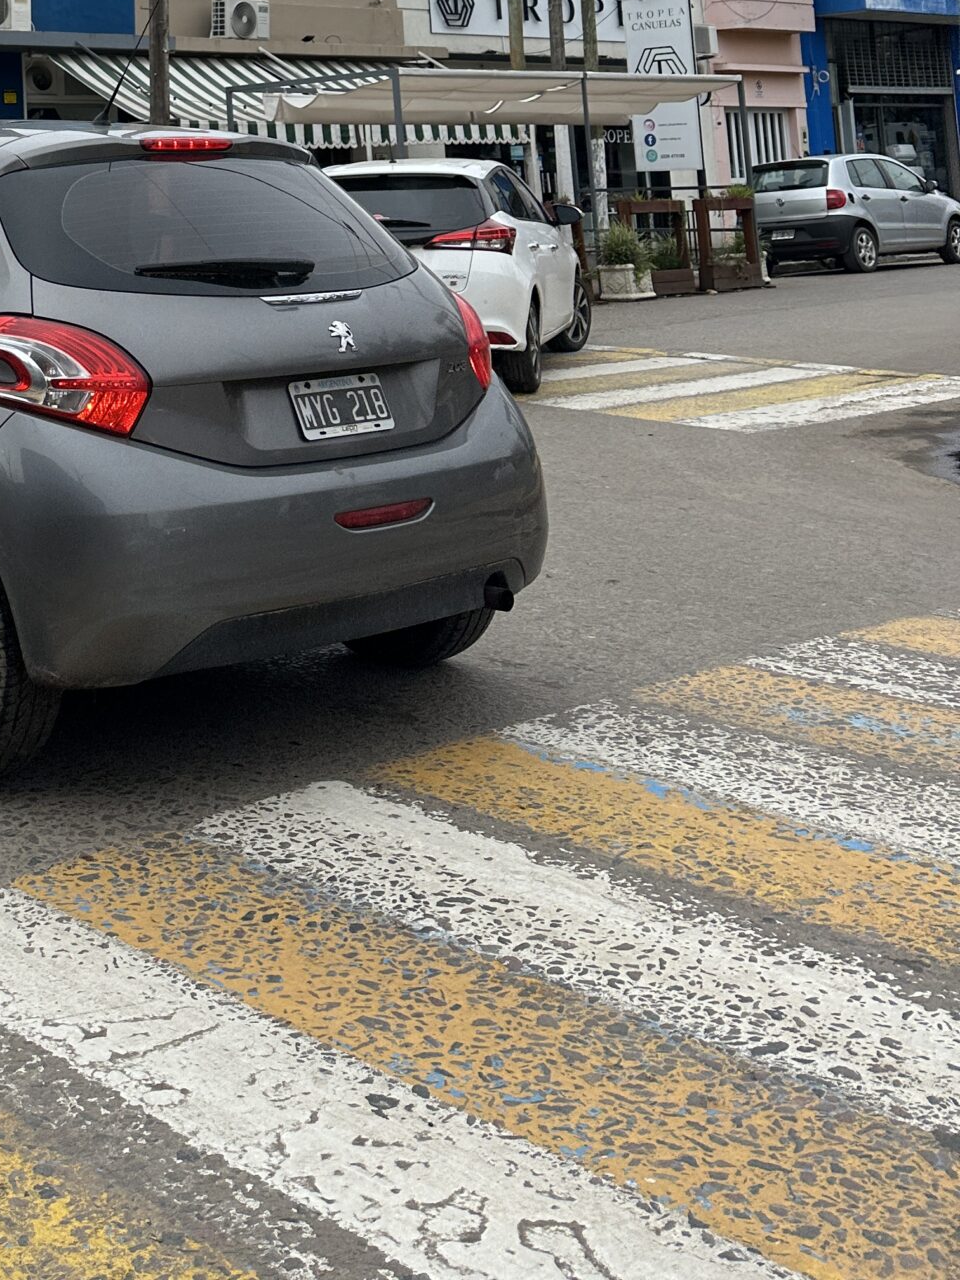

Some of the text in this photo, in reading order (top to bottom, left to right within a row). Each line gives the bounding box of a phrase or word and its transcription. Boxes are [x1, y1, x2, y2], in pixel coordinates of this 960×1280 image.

[627, 7, 685, 20] TROPEA
[297, 388, 388, 428] MYG 218
